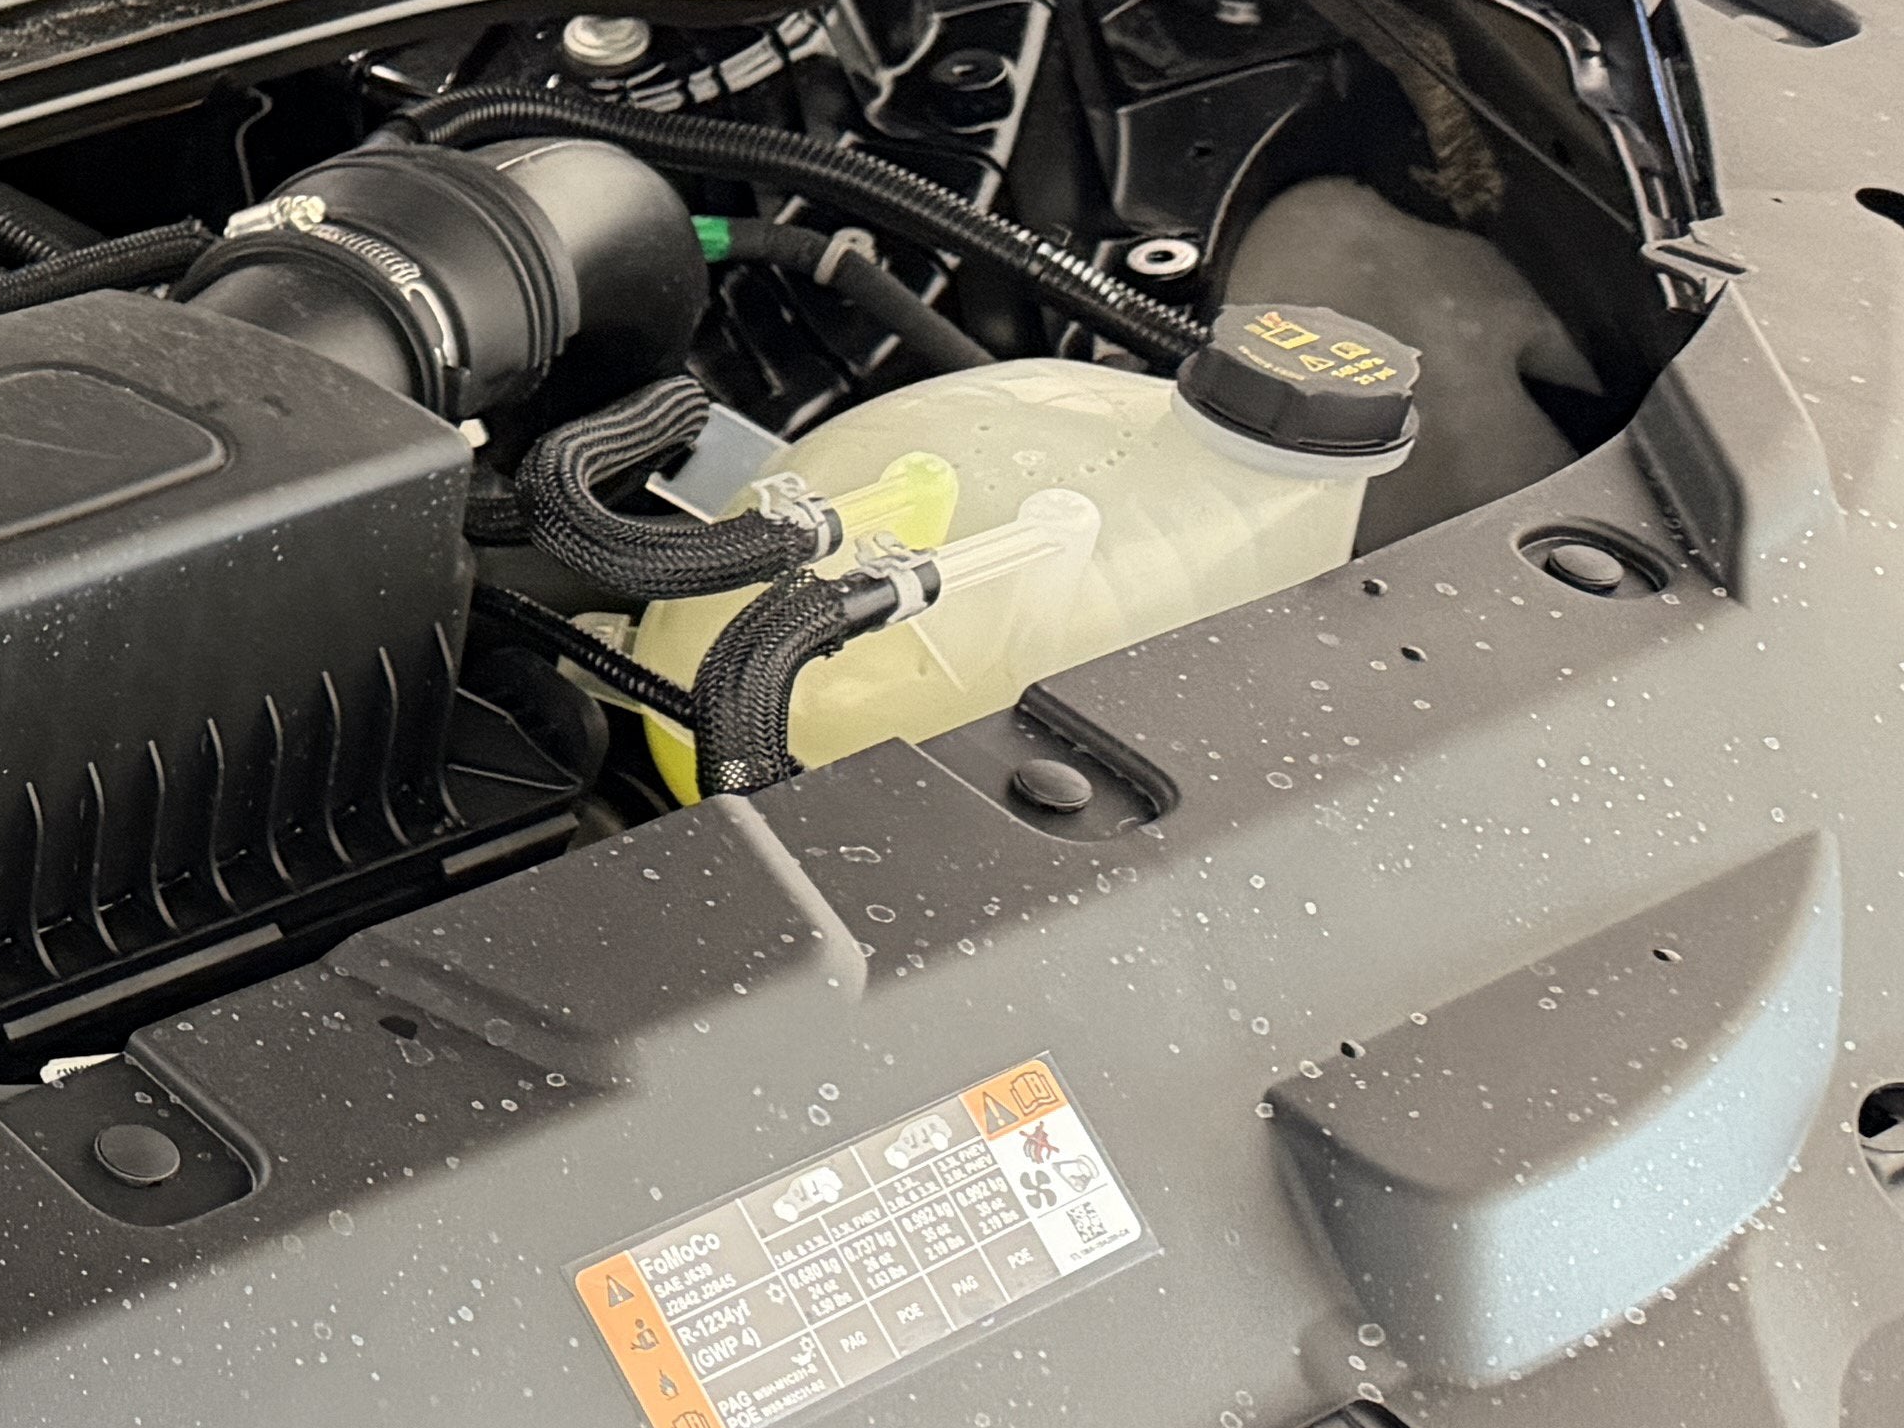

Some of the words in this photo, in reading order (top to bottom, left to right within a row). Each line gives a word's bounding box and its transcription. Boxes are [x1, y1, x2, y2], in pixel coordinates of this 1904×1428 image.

[956, 1181, 990, 1206] 0.992
[987, 1177, 1007, 1191] kg
[902, 1207, 936, 1232] 0.992
[933, 1202, 953, 1216] kg
[639, 1234, 719, 1278] FoMoCo
[844, 1236, 875, 1261] 0.737
[875, 1231, 896, 1246] kg
[1007, 1248, 1033, 1268] POE
[654, 1276, 684, 1297] SAE
[684, 1263, 712, 1284] J639
[820, 1258, 841, 1273] kg
[952, 1275, 978, 1296] PAG
[678, 1299, 750, 1344] R-1234yf
[897, 1303, 923, 1323] POE
[692, 1336, 737, 1373] (GWP
[742, 1327, 760, 1347] 4)
[840, 1331, 866, 1352] PAG
[718, 1391, 751, 1416] PAG
